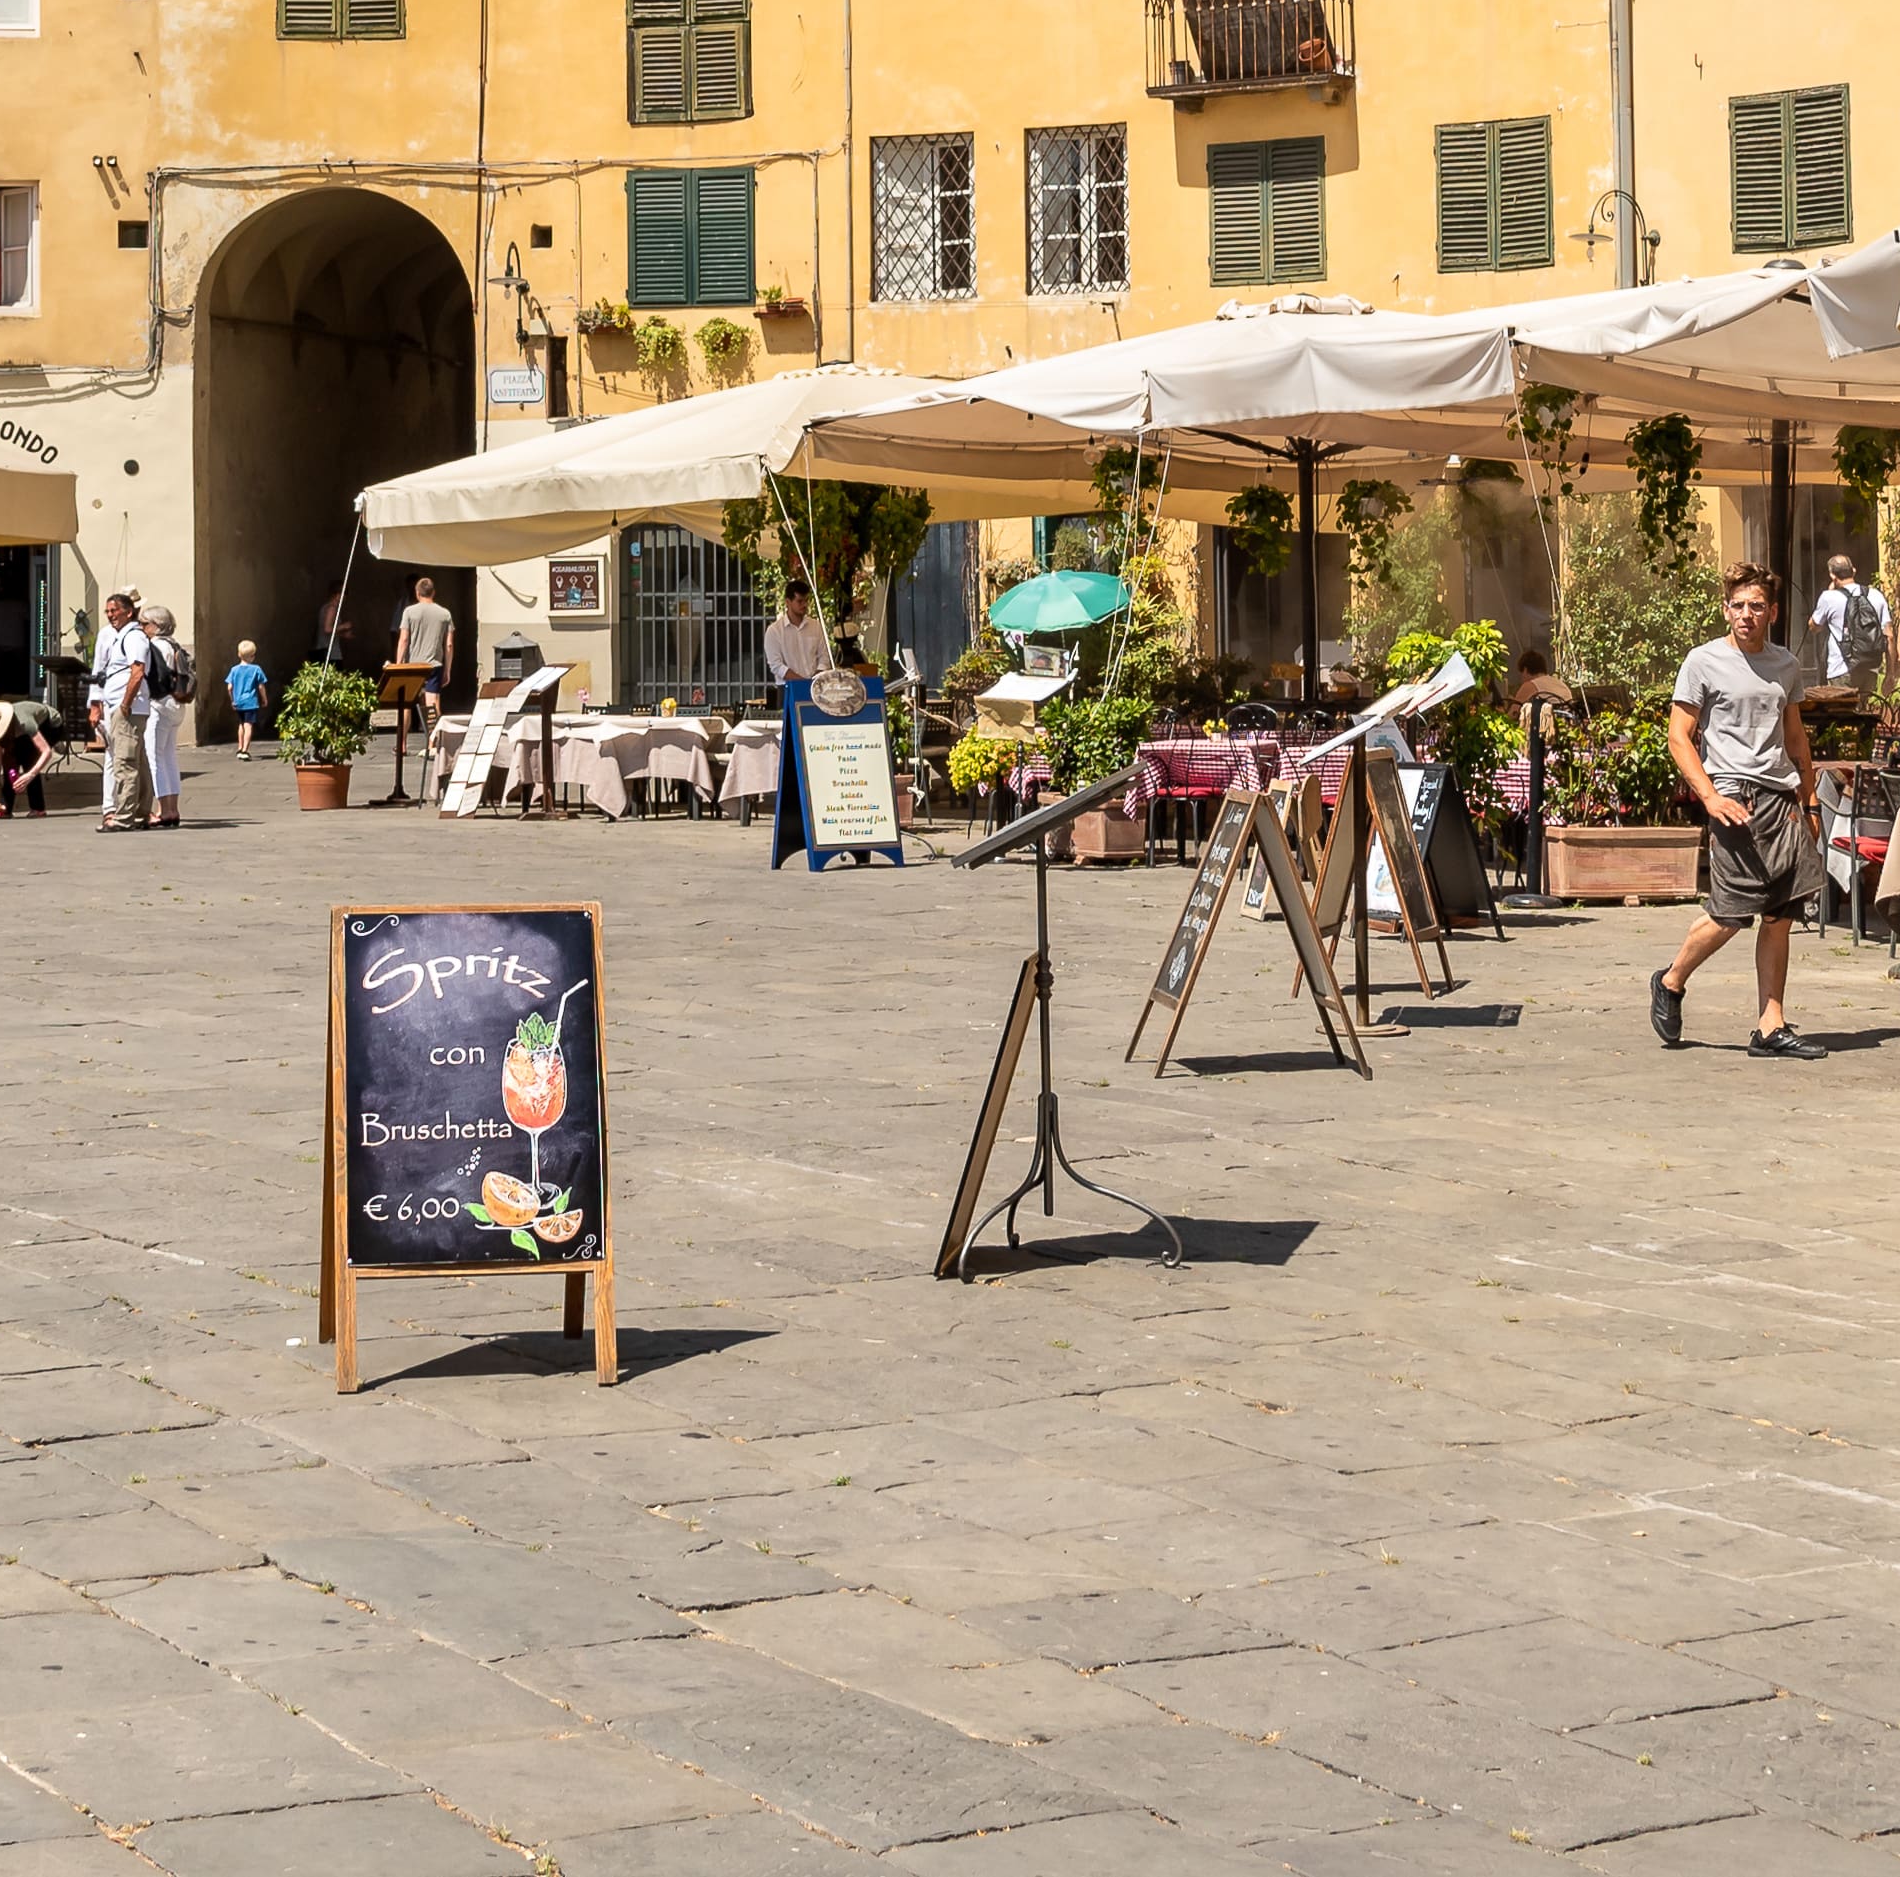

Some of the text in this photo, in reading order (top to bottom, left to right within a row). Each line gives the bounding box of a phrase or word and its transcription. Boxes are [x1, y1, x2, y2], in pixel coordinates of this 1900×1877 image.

[362, 946, 552, 1015] Spritz
[429, 1046, 486, 1065] con
[361, 1110, 513, 1147] Bruschetta
[363, 1193, 460, 1225] € 6,00
